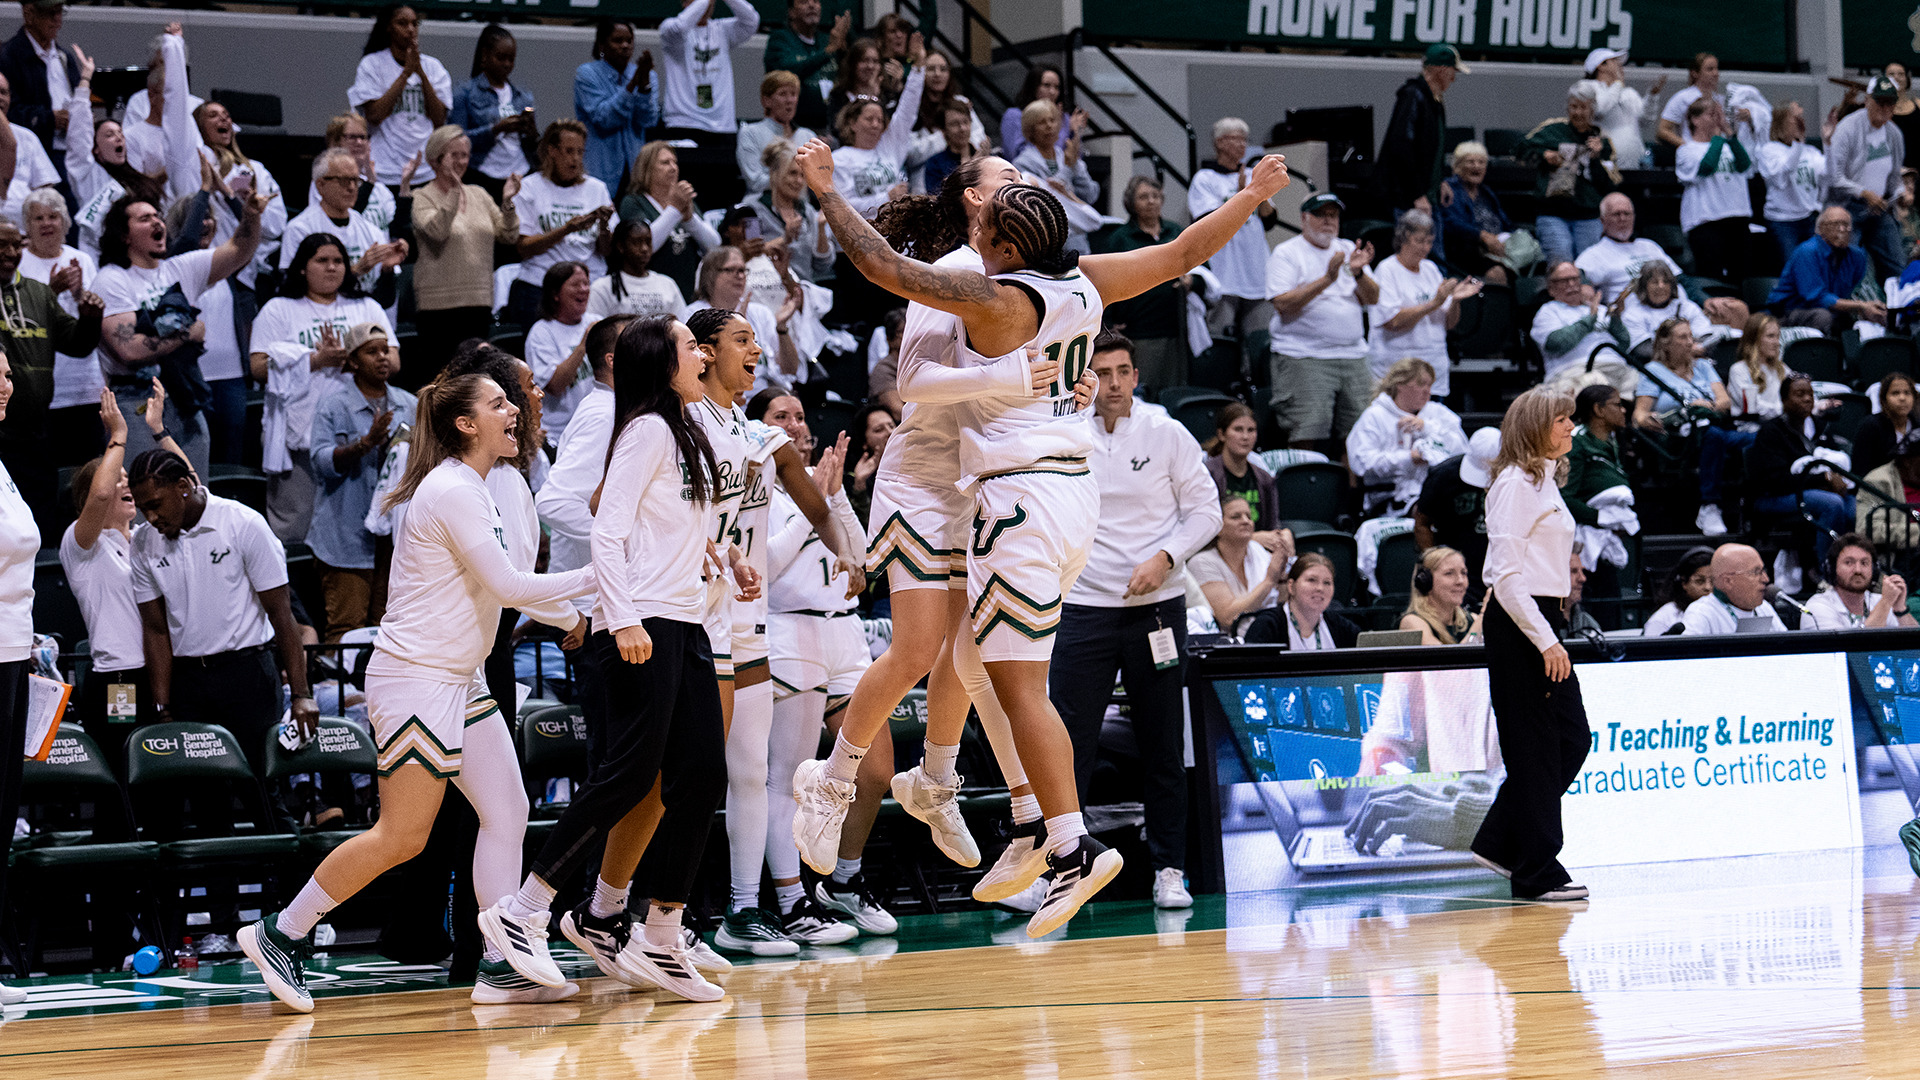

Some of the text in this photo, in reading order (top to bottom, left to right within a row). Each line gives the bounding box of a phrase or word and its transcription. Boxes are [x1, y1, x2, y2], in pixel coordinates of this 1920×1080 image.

[1044, 334, 1088, 398] 10
[819, 557, 830, 586] 1
[315, 726, 349, 737] Tampa
[538, 721, 569, 733] TGH
[1607, 719, 1708, 754] Teaching
[1714, 716, 1732, 746] &
[1739, 712, 1834, 746] Learning
[180, 731, 216, 742] Tampa
[317, 732, 356, 744] General
[52, 738, 78, 748] ampa
[145, 738, 179, 750] TGH
[183, 738, 223, 750] General
[1694, 752, 1827, 787] Certificate
